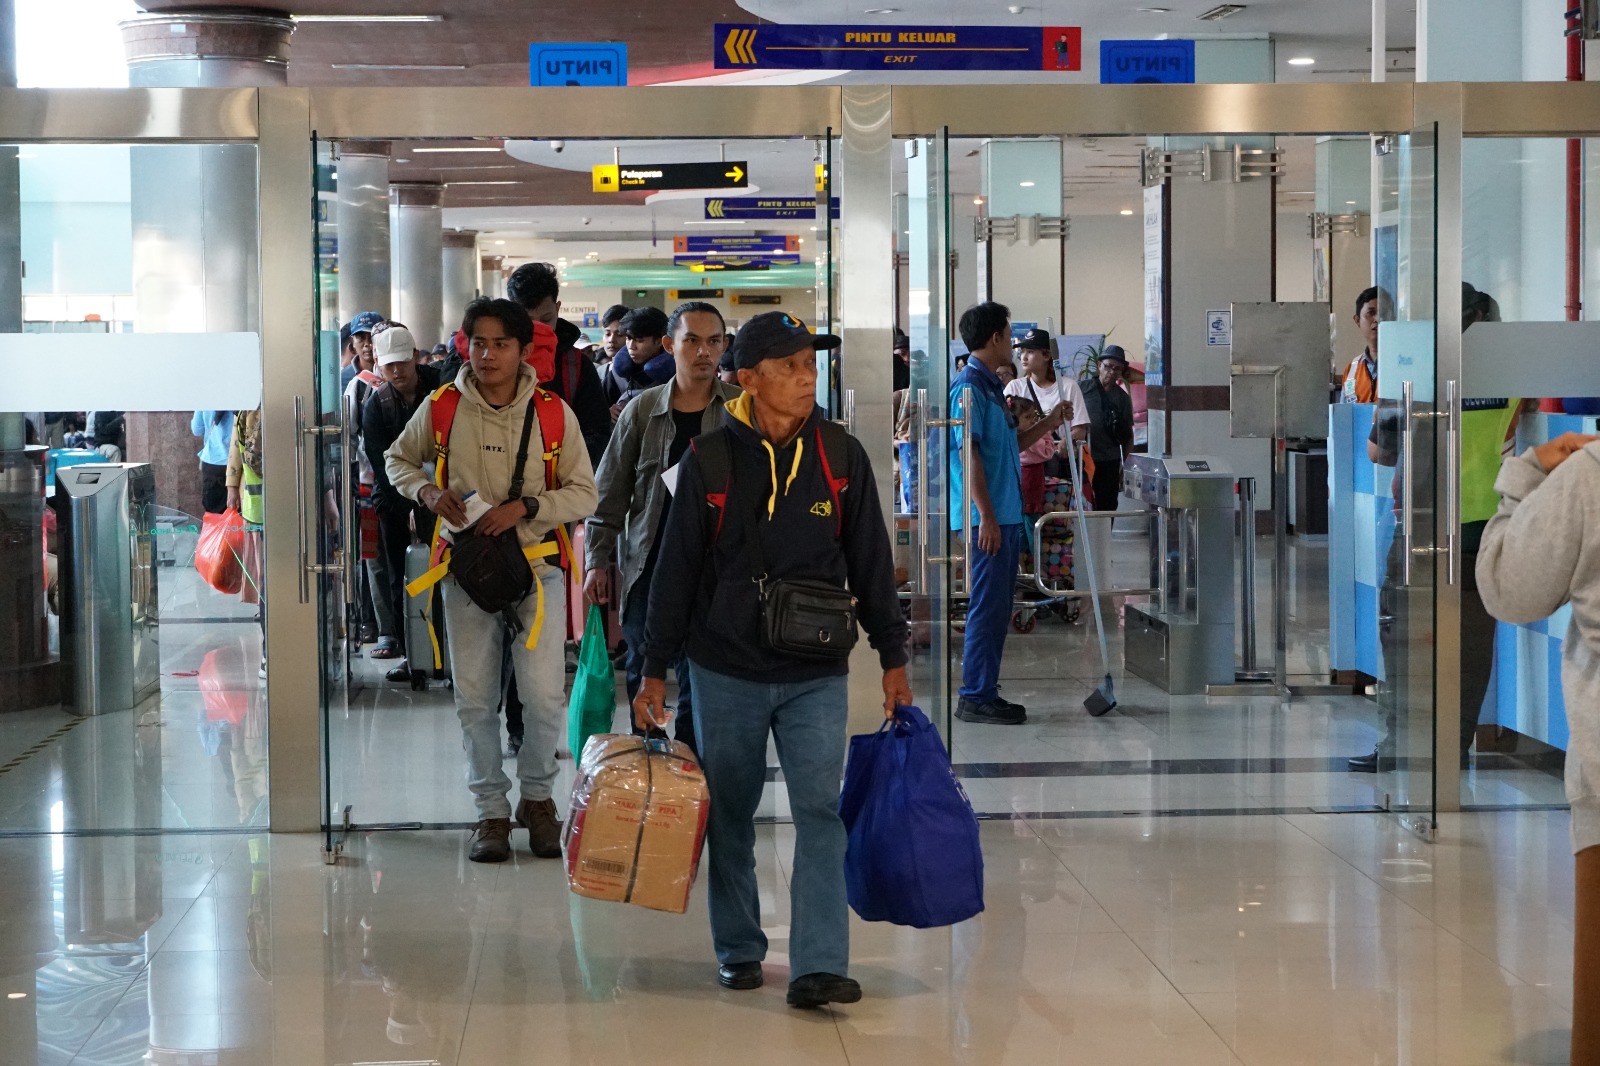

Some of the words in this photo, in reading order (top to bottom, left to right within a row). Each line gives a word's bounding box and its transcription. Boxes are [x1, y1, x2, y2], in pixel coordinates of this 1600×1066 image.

[845, 32, 892, 43] PINTU
[898, 32, 957, 43] KELUAR
[883, 55, 918, 63] EXIT
